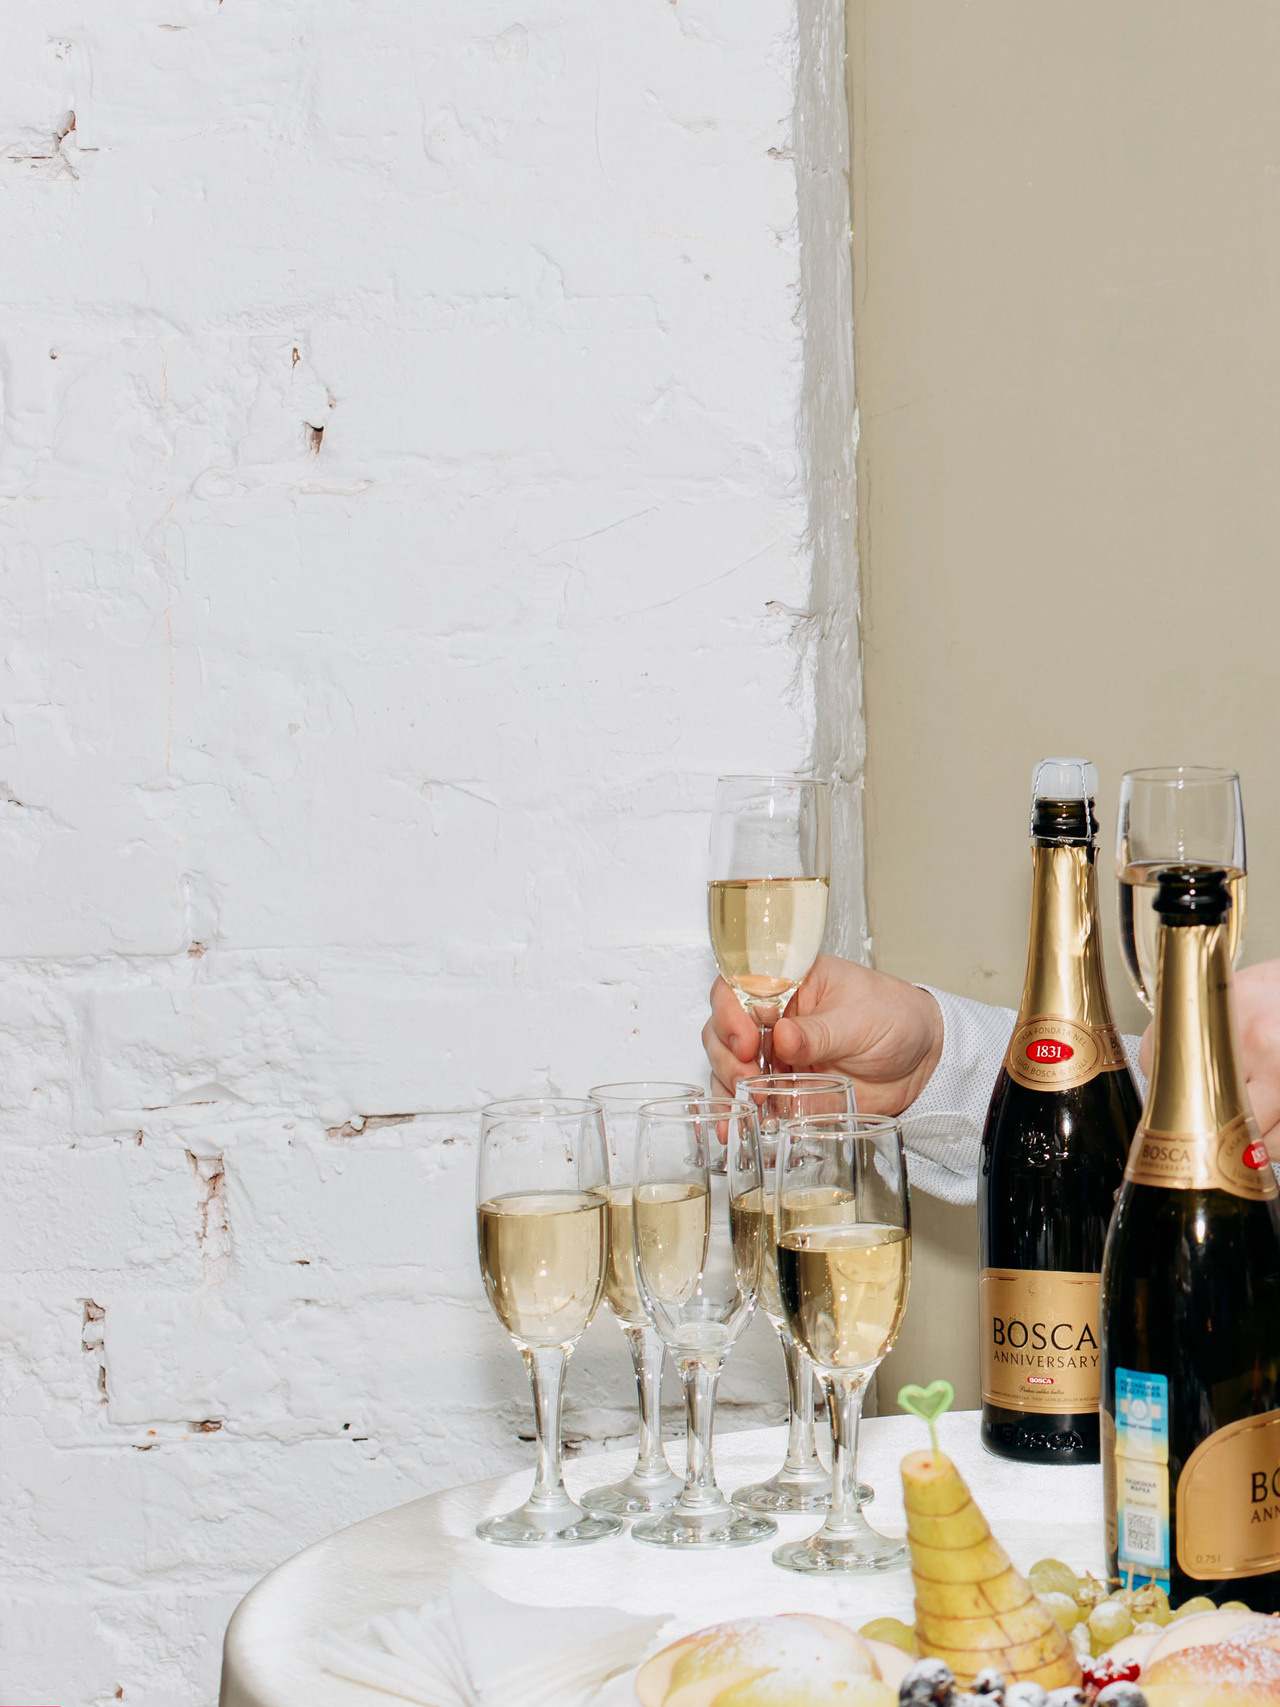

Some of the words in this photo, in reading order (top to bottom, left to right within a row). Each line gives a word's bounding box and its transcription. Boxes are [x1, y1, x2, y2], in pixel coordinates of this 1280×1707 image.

[1035, 1027, 1070, 1037] FONDATA
[1073, 1034, 1087, 1047] NEL
[1036, 1045, 1061, 1058] 1831
[1030, 1067, 1057, 1077] BOSCA
[1142, 1144, 1191, 1162] BOSCA
[993, 1317, 1099, 1350] BOSCA
[994, 1350, 1099, 1368] ANNIVERSARY
[1029, 1376, 1052, 1385] BOSCA
